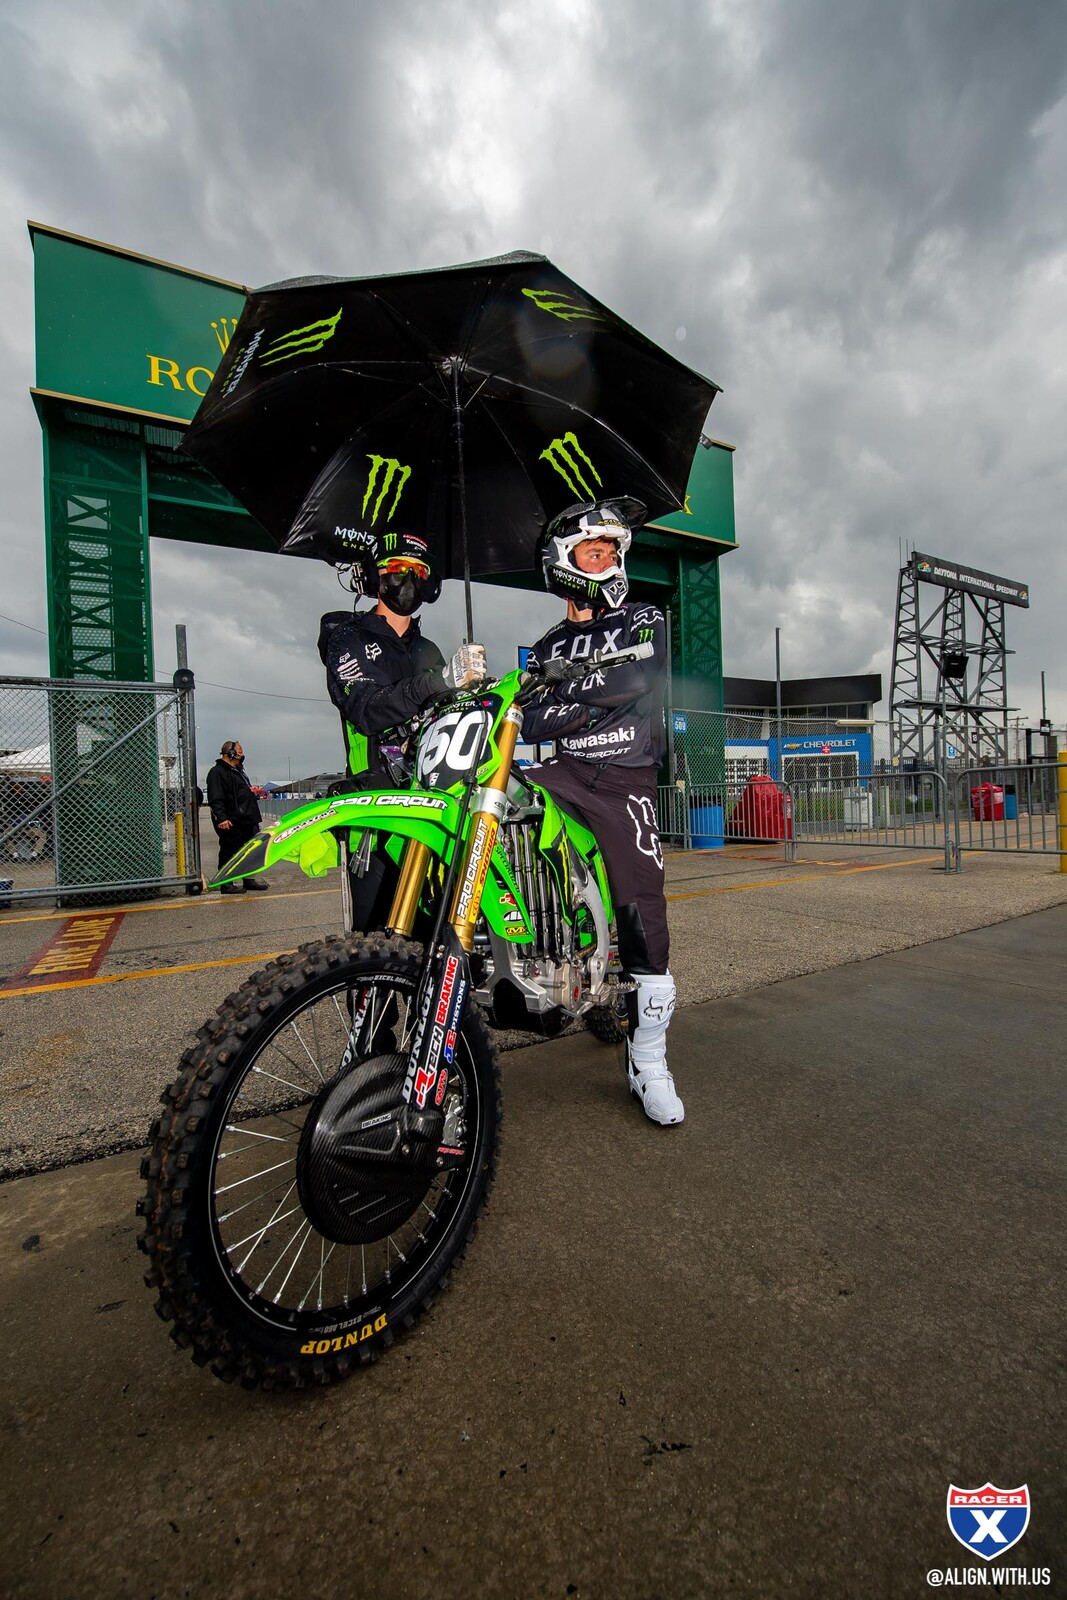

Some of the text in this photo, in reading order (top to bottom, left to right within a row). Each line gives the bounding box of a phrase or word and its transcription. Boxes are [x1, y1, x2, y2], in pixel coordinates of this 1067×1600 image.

[552, 568, 587, 587] MONSTER
[933, 567, 1019, 597] DAYTONA INTERNATIONAL SPEEDWAY
[551, 628, 623, 660] FOX
[561, 726, 636, 750] Kawasaki
[586, 747, 631, 759] CIRCUIT
[803, 739, 857, 749] CHEVROLET
[375, 795, 448, 810] CIRCUIT
[456, 883, 473, 919] PRO
[466, 819, 488, 886] CIRCUIT
[480, 828, 496, 885] SHOWA
[435, 955, 459, 1026] BRAKING
[452, 979, 466, 1031] PISTONS
[300, 1312, 388, 1354] DUNLOP
